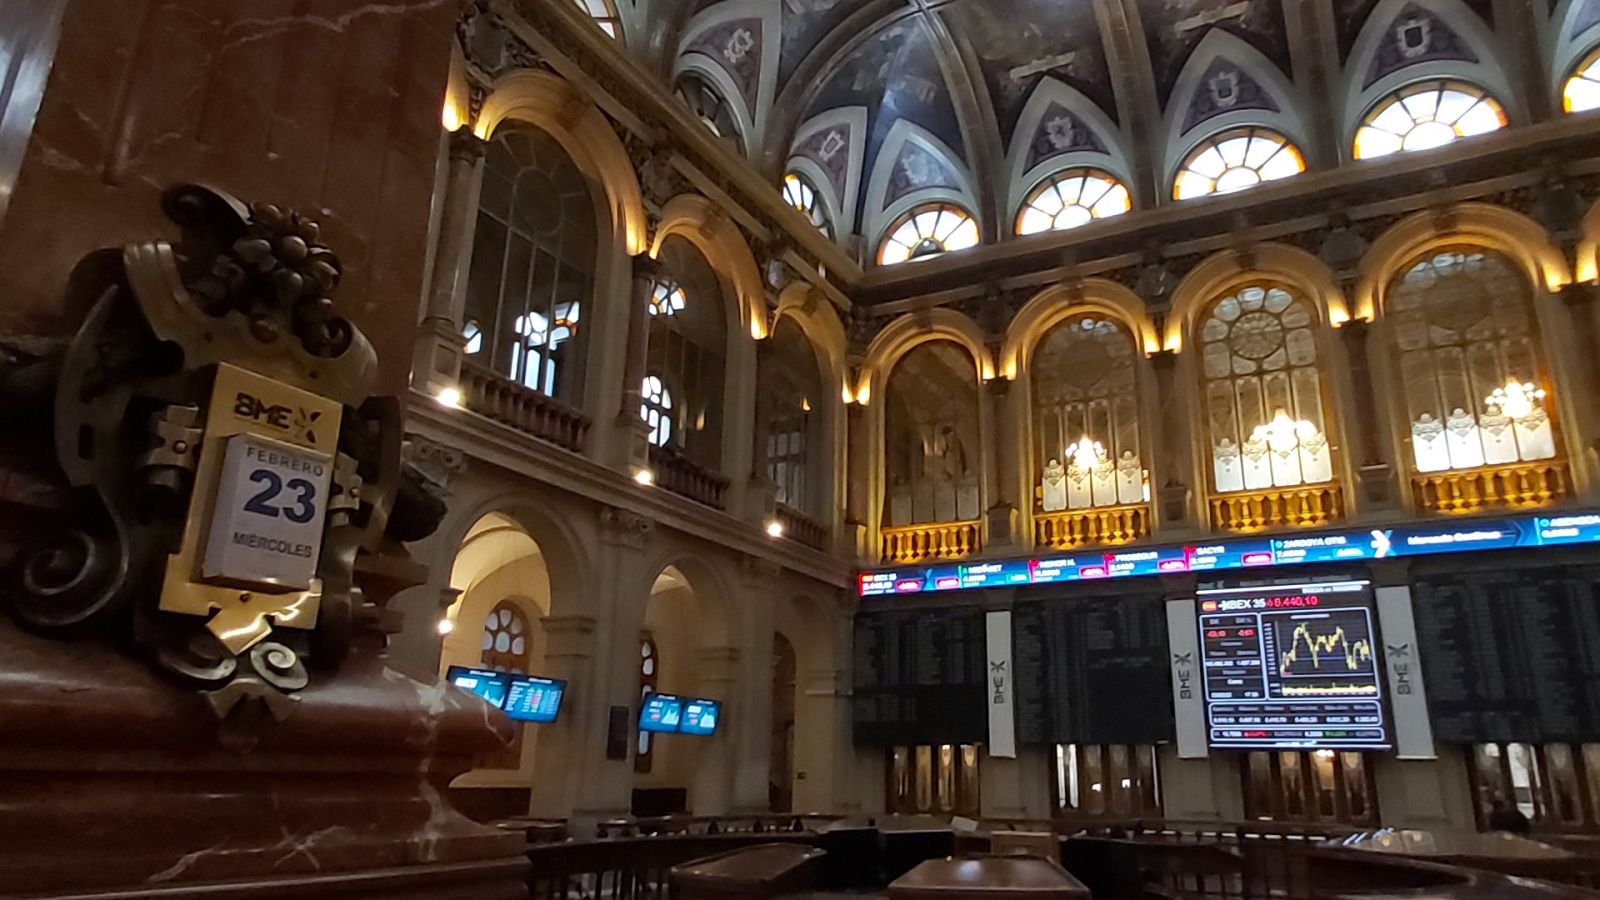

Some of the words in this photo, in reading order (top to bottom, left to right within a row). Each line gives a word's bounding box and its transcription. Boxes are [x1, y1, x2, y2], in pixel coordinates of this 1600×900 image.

[246, 446, 324, 477] FEBRERO
[243, 469, 316, 524] 23
[992, 676, 1004, 704] BME
[1178, 670, 1191, 699] BME
[1394, 663, 1411, 695] BME
